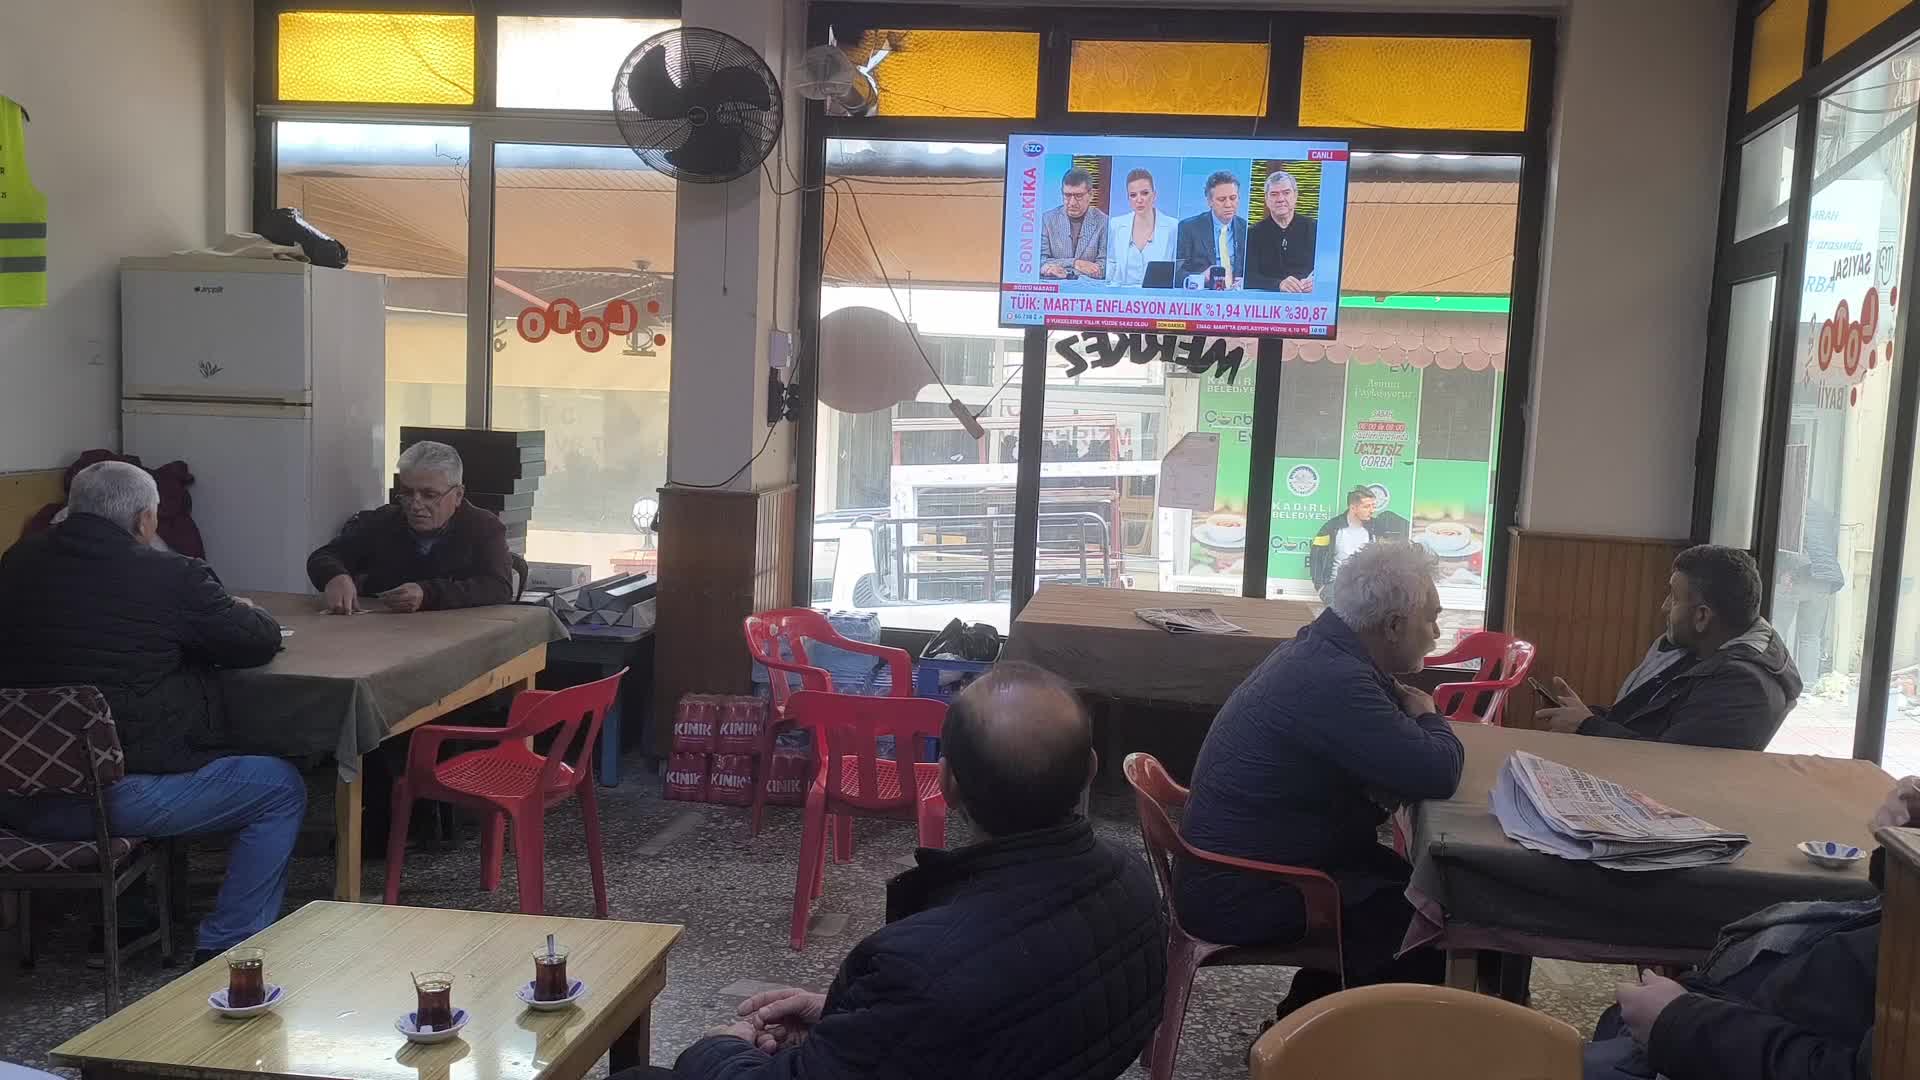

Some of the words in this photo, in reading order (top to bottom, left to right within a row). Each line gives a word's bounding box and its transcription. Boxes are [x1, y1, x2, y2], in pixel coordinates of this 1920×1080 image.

[1024, 144, 1042, 153] SZC
[1311, 151, 1334, 159] CANLI
[1020, 167, 1037, 233] DAKİKA
[1019, 239, 1033, 273] SON
[1010, 293, 1040, 310] TÜİK:
[1043, 297, 1093, 312] MART'TA
[1096, 299, 1166, 315] ENFLASYON
[1169, 302, 1202, 317] AYLIK
[1206, 303, 1241, 319] %1,94
[1244, 304, 1282, 319] YILLIK
[1285, 305, 1328, 322] %30,87
[1354, 441, 1405, 457] ÜCRETSİZ
[1361, 456, 1393, 470] ÇORBA
[674, 722, 712, 736] KINIK
[719, 722, 758, 736] KINIK
[711, 772, 746, 789] KINIK
